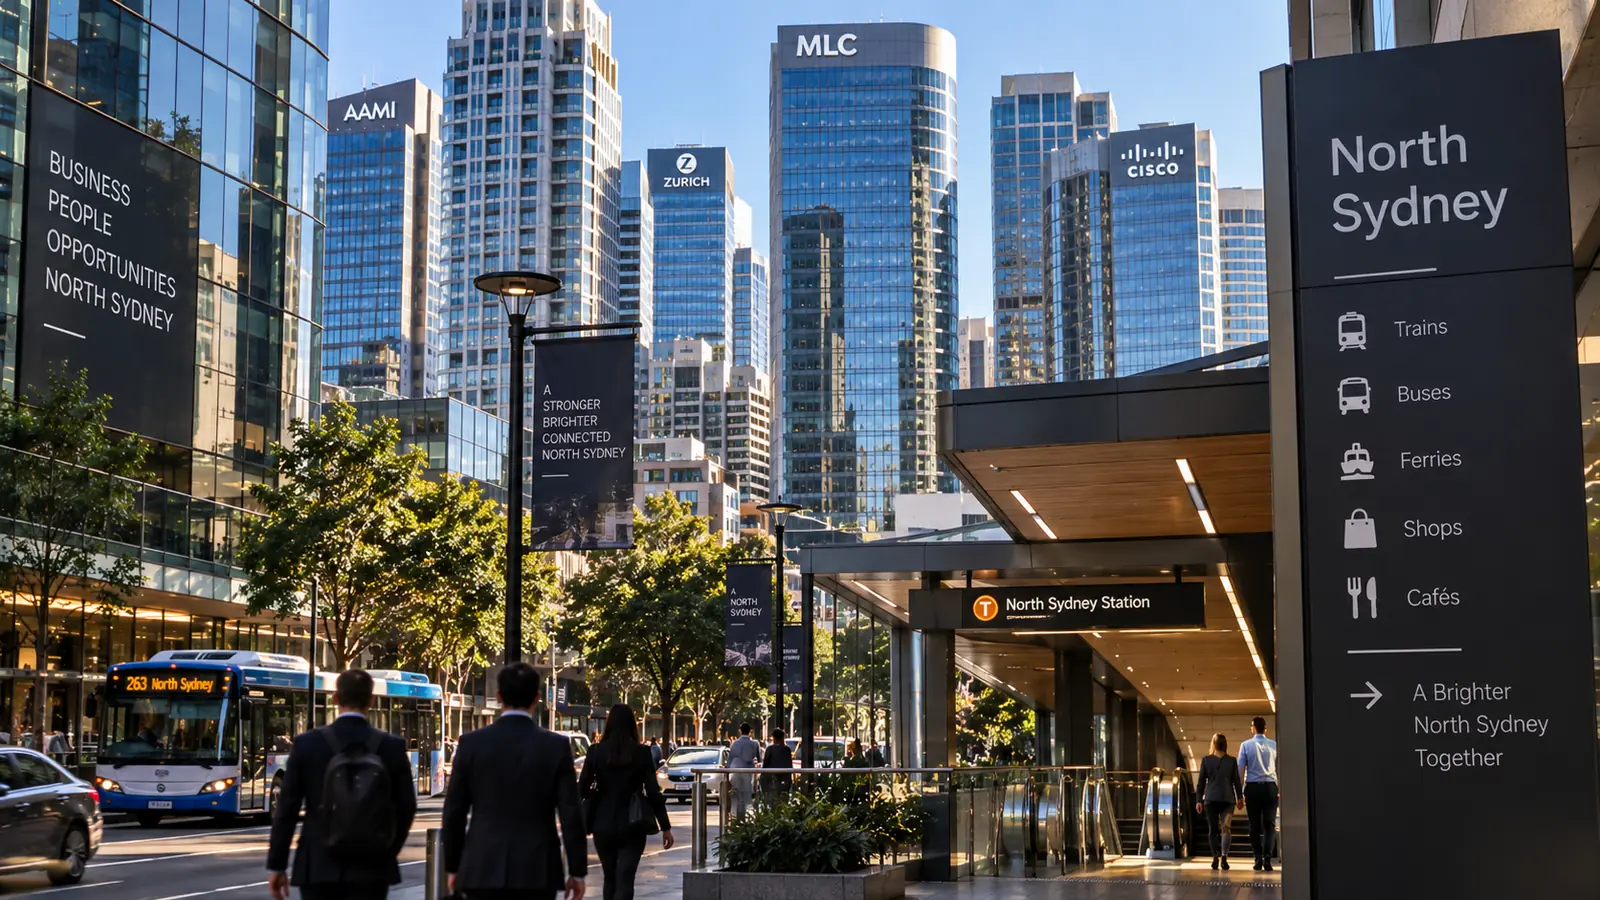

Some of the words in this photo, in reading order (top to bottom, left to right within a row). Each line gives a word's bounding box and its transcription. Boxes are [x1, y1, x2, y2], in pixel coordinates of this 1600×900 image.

[797, 34, 857, 56] MLC
[343, 101, 397, 122] AAMI
[1331, 124, 1467, 177] North
[1128, 160, 1178, 177] CISCO
[49, 150, 131, 208] BUSINESS
[664, 177, 709, 187] ZURICH
[48, 189, 113, 237] PEOPLE
[1332, 184, 1508, 241] Sydney
[46, 228, 176, 300] OPPORTUNITIES
[45, 266, 106, 309] NORTH
[111, 290, 175, 333] SYDNEY
[1394, 320, 1447, 337] Trains
[543, 384, 552, 395] A
[1398, 386, 1451, 402] Buses
[544, 399, 600, 411] STRONGER
[543, 415, 597, 427] BRIGHTER
[543, 431, 610, 444] CONNECTED
[542, 448, 580, 461] NORTH
[582, 446, 626, 460] SYDNEY
[1401, 451, 1461, 468] Ferries
[1405, 520, 1462, 540] Shops
[730, 587, 737, 595] A
[1408, 588, 1459, 606] Cafés
[730, 597, 758, 607] NORTH
[1006, 596, 1044, 611] North
[1048, 596, 1098, 613] Sydney
[1101, 594, 1150, 609] Station
[126, 675, 148, 691] 263
[151, 677, 179, 691] North
[179, 677, 214, 694] Sydney
[1412, 683, 1428, 702] A
[1433, 682, 1512, 706] Brighter
[1414, 714, 1470, 734] North
[1476, 714, 1549, 738] Sydney
[1414, 747, 1504, 772] Together
